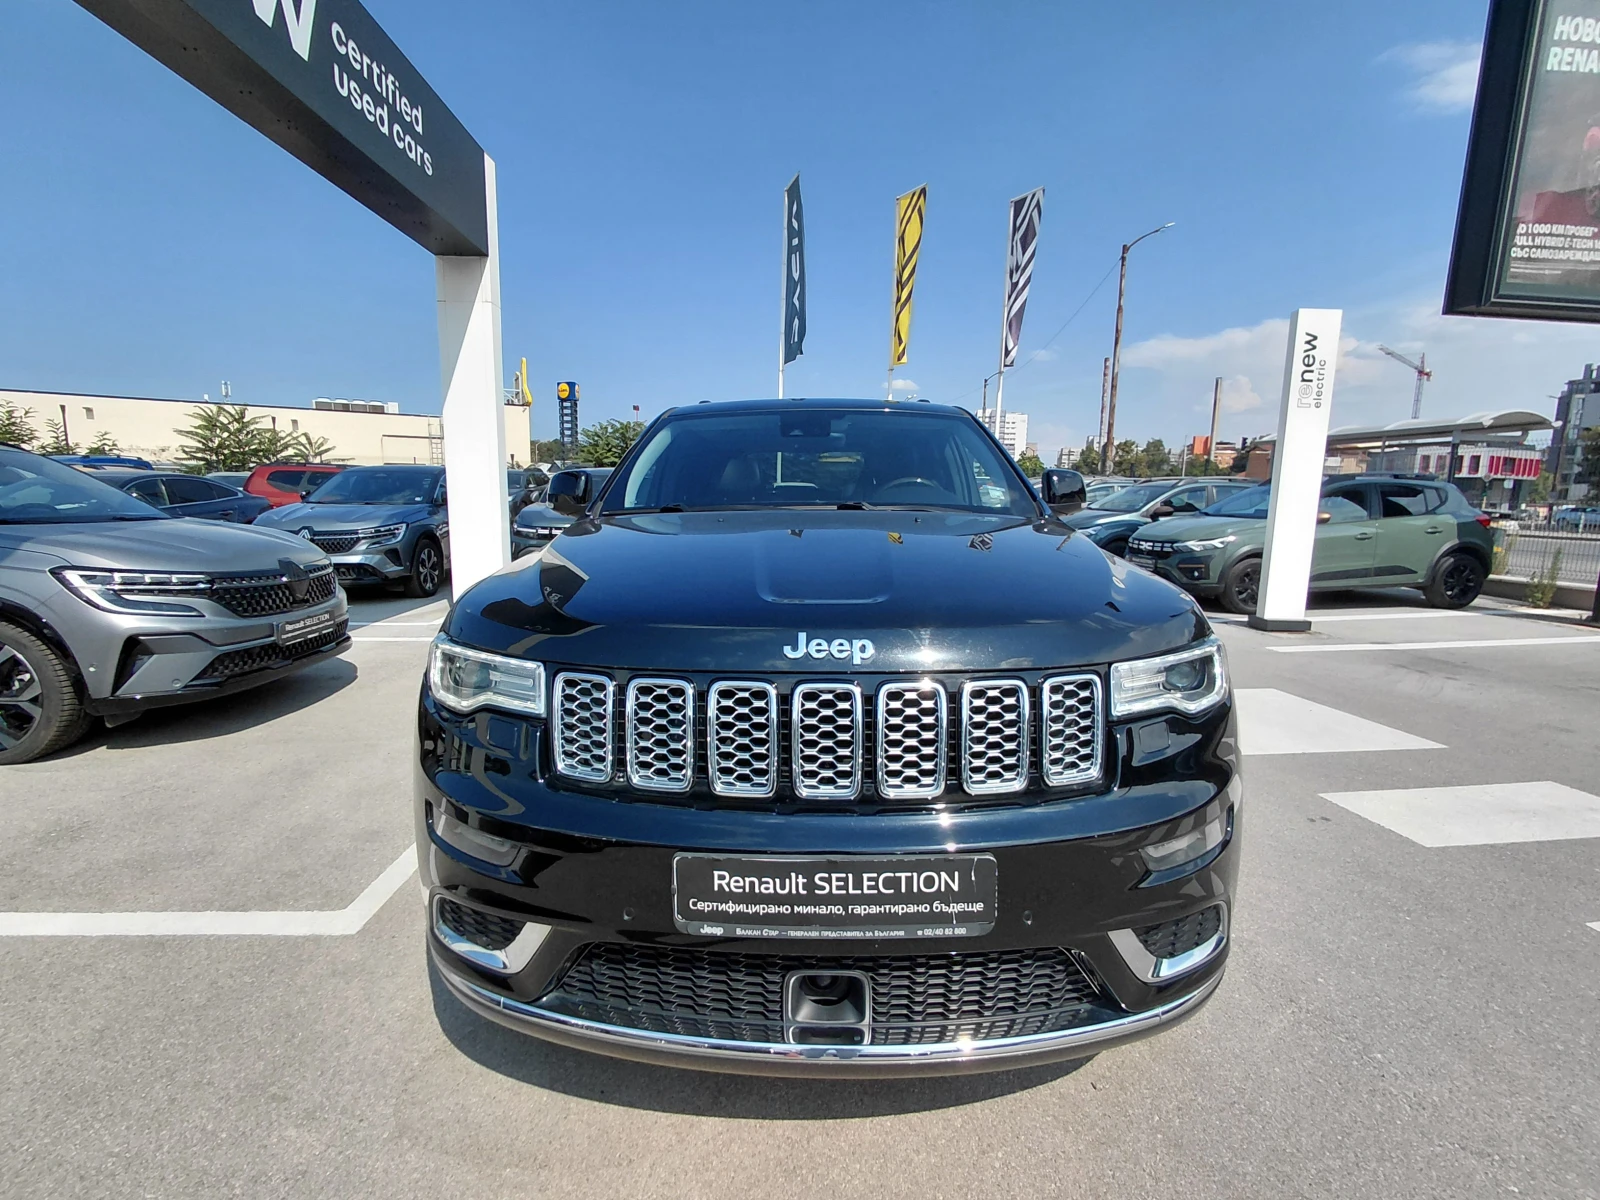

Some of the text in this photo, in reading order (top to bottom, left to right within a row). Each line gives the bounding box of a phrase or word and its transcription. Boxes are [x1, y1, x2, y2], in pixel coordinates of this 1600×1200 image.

[1547, 46, 1600, 73] RENA
[331, 22, 423, 135] certified
[333, 63, 433, 176] used cars
[1297, 332, 1318, 408] renew
[1313, 359, 1327, 409] electric
[783, 631, 875, 665] Jeep
[713, 870, 959, 895] Renault SELECTION
[689, 898, 984, 917] Сертифицирано минало, гарантирано бъдеще
[700, 924, 724, 936] Jeep
[923, 928, 943, 936] 02/40
